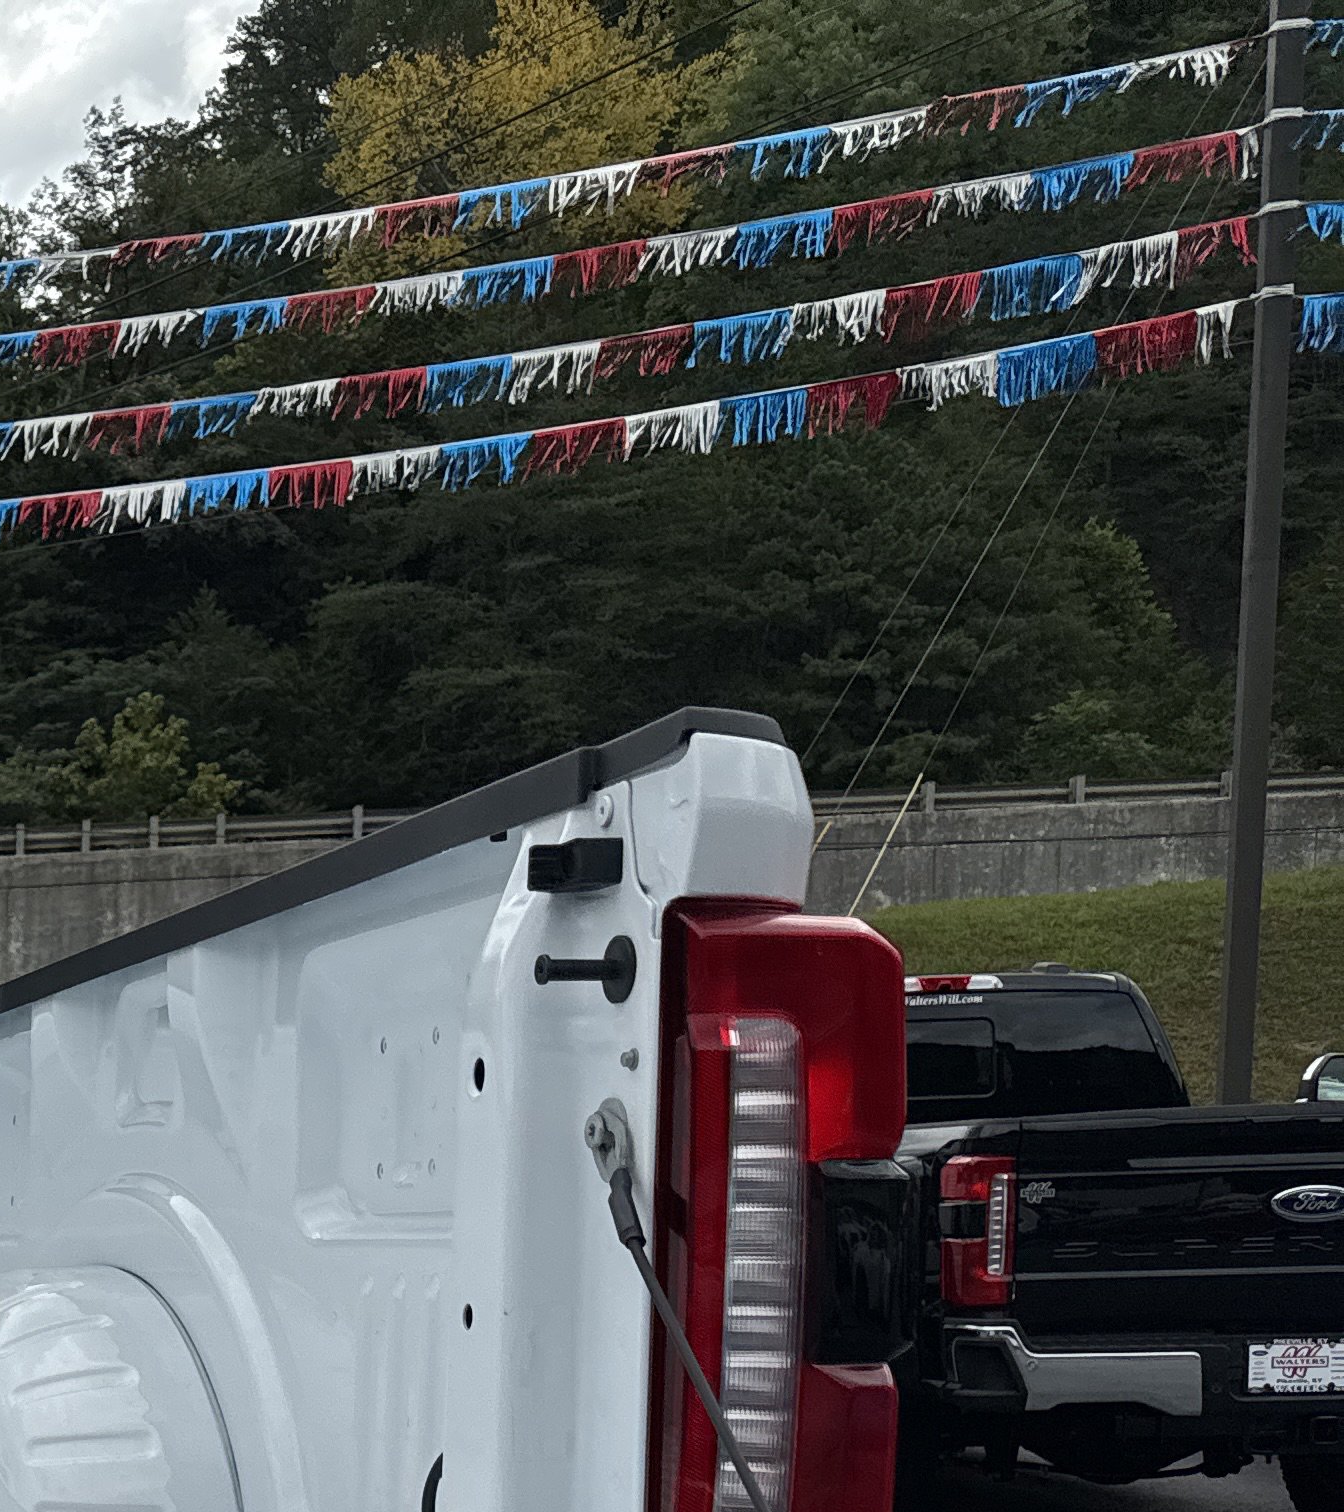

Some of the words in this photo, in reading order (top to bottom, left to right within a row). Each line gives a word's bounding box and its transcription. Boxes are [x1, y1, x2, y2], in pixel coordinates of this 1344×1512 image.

[1293, 1191, 1340, 1211] Ford
[1275, 1358, 1326, 1366] WALTERS
[1273, 1384, 1328, 1393] WALTERS
